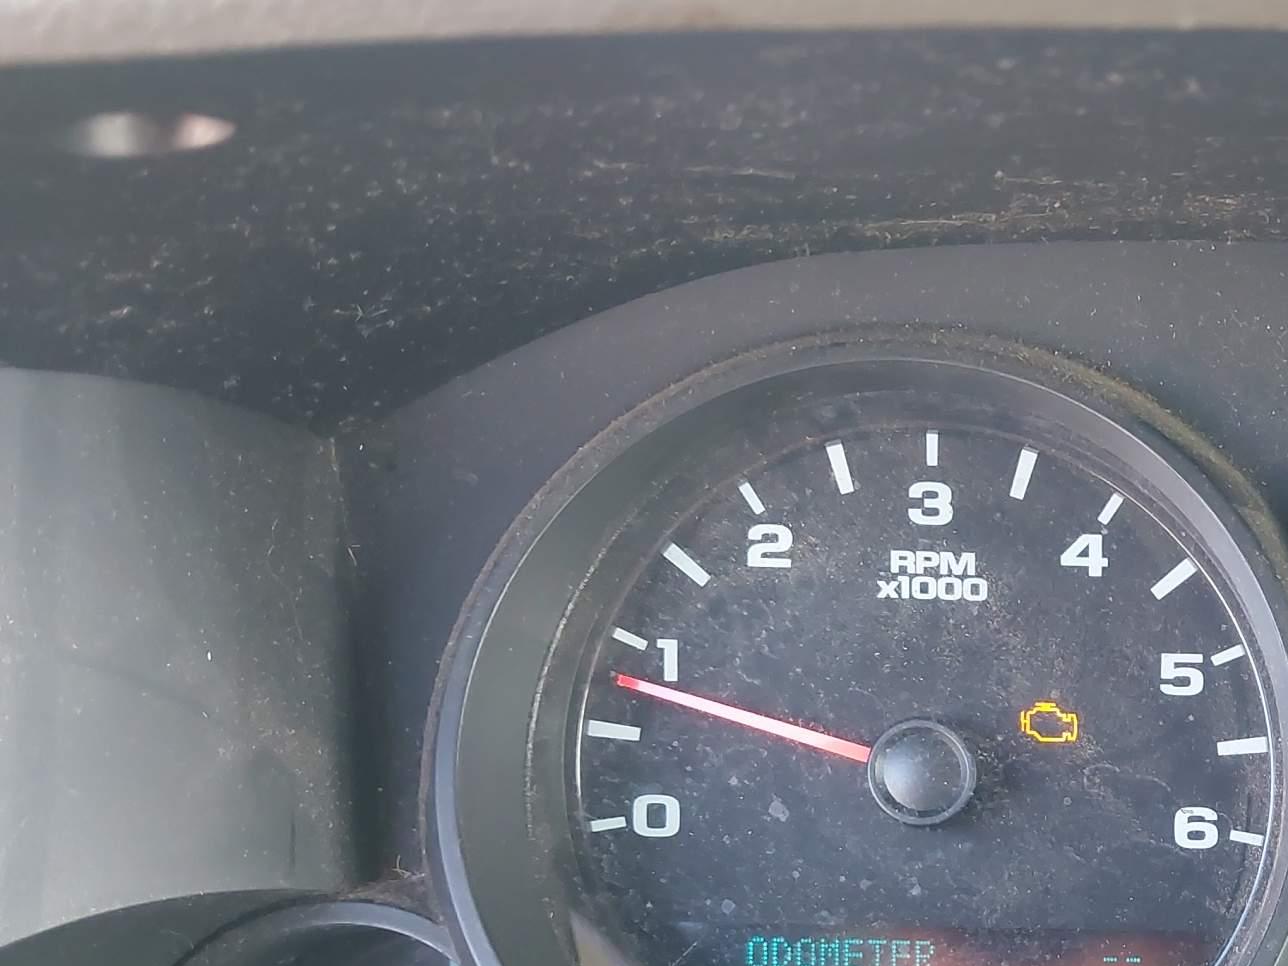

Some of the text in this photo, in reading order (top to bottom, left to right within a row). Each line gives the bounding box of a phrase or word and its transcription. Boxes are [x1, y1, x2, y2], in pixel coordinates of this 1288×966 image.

[908, 482, 954, 525] 3
[747, 524, 793, 568] 2
[890, 551, 976, 575] RPM
[1060, 534, 1108, 577] 4
[877, 576, 988, 602] x1000
[656, 638, 679, 682] 1
[1159, 653, 1204, 696] 5
[633, 794, 681, 838] 0
[1174, 806, 1219, 849] 6
